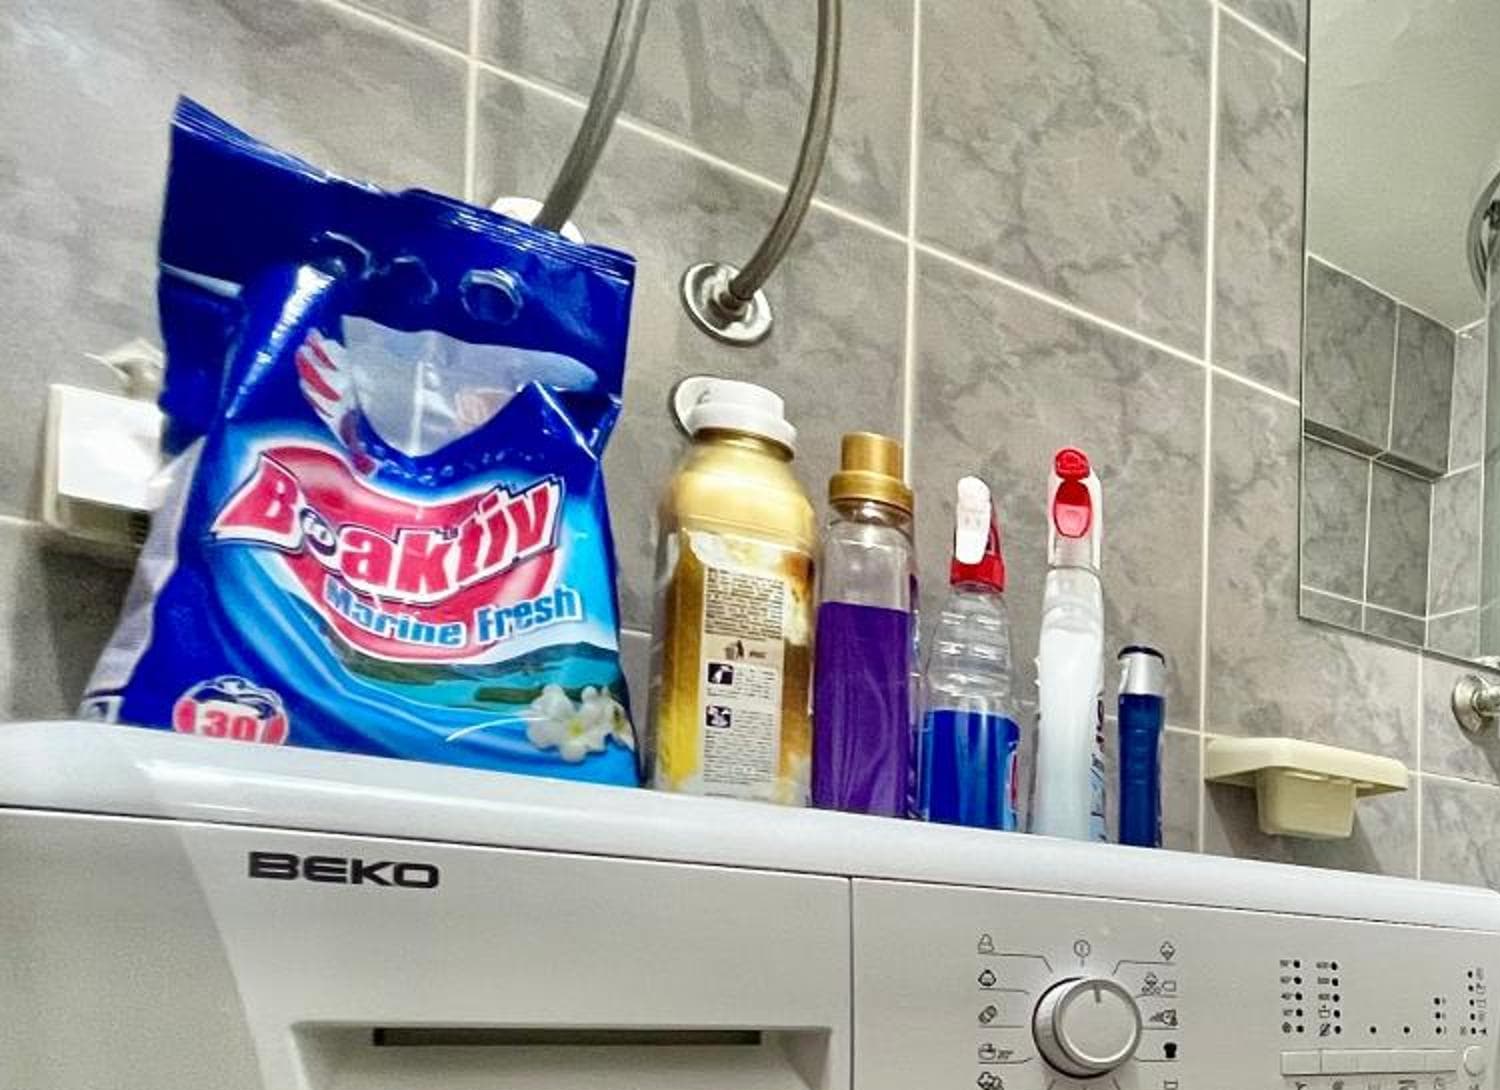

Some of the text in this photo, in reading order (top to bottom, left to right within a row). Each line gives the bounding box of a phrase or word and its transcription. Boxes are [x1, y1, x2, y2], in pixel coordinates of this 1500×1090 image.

[324, 574, 581, 648] Marine Fresh
[248, 851, 440, 889] BEKO
